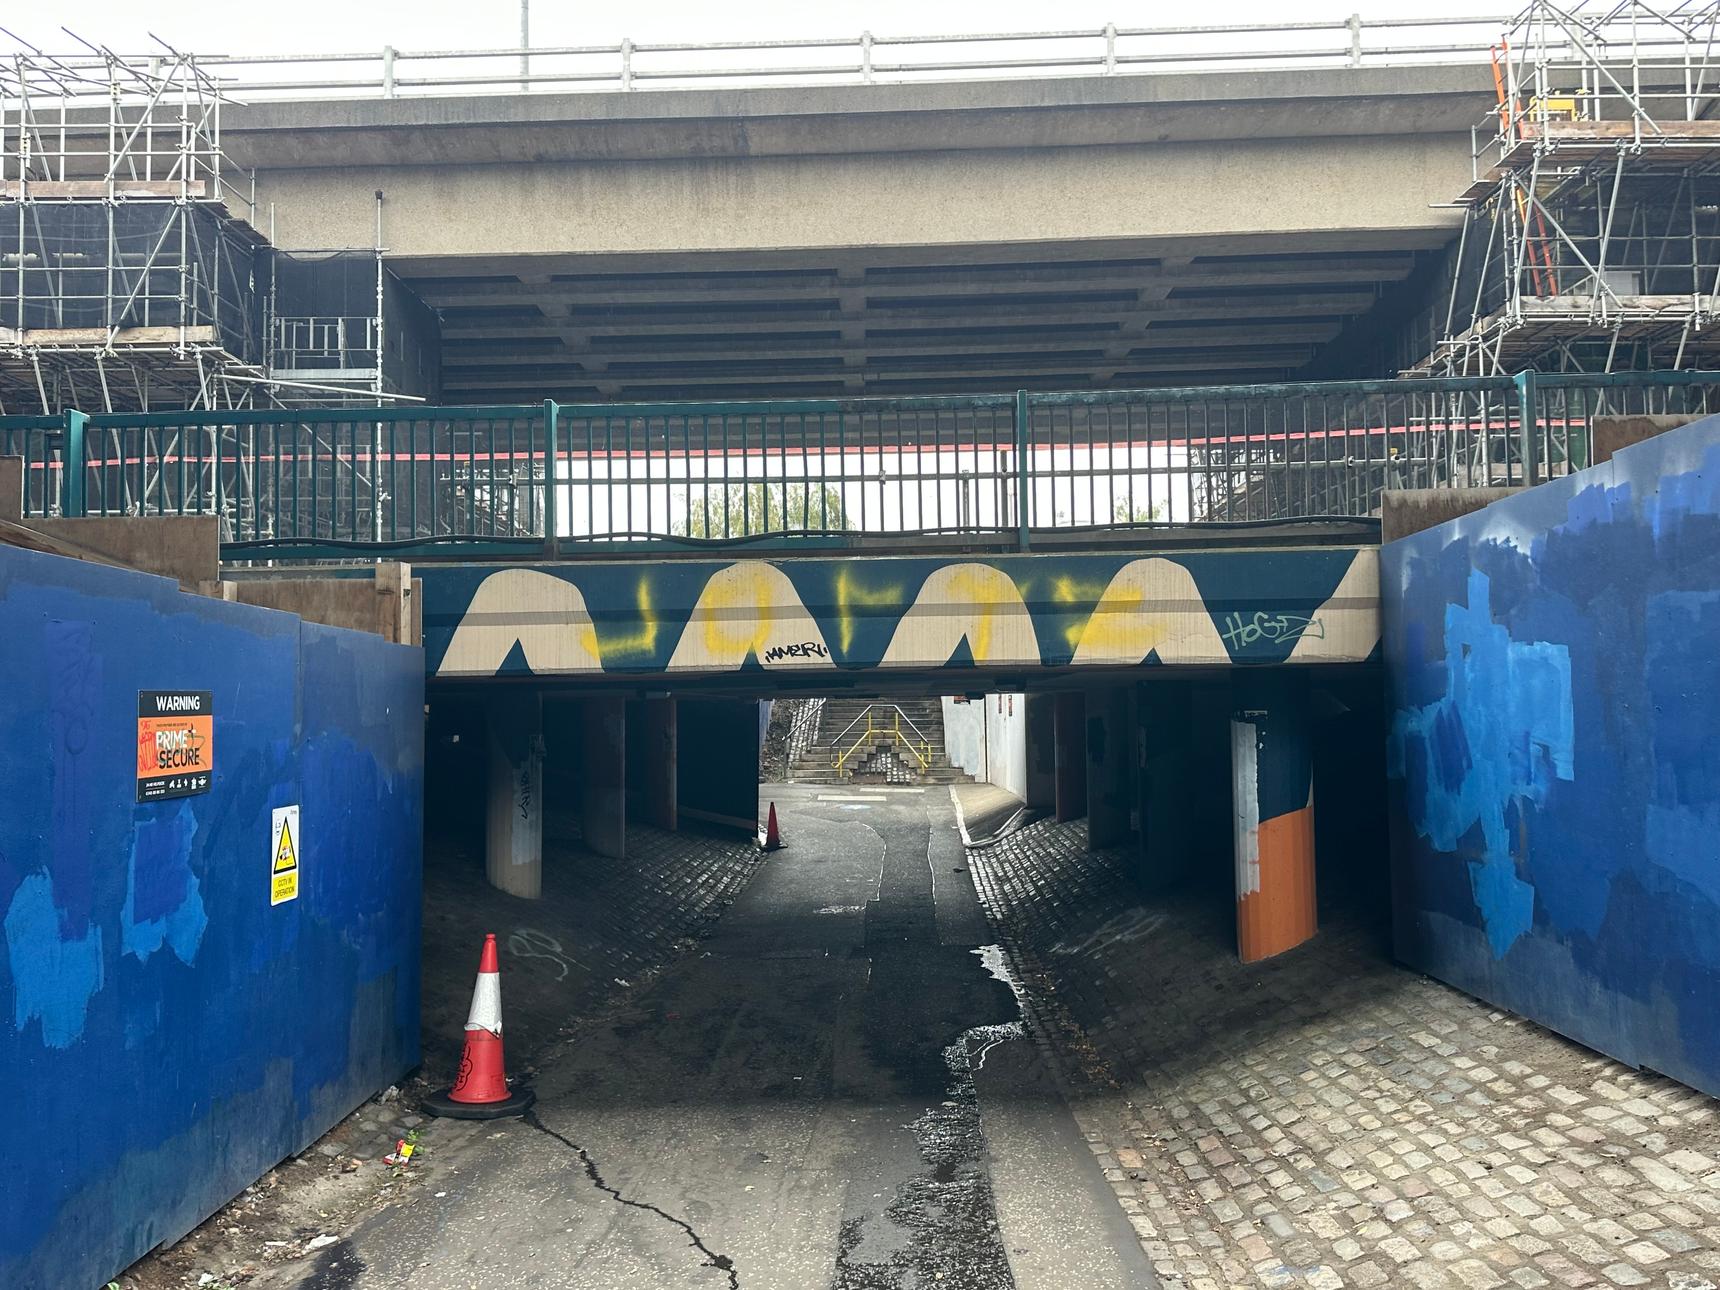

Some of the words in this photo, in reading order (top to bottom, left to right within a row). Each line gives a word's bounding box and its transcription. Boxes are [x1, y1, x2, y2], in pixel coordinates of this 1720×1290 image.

[156, 695, 201, 711] WARNING
[155, 729, 188, 750] PRIME
[158, 747, 200, 769] SECURE
[275, 886, 295, 898] OPERATION
